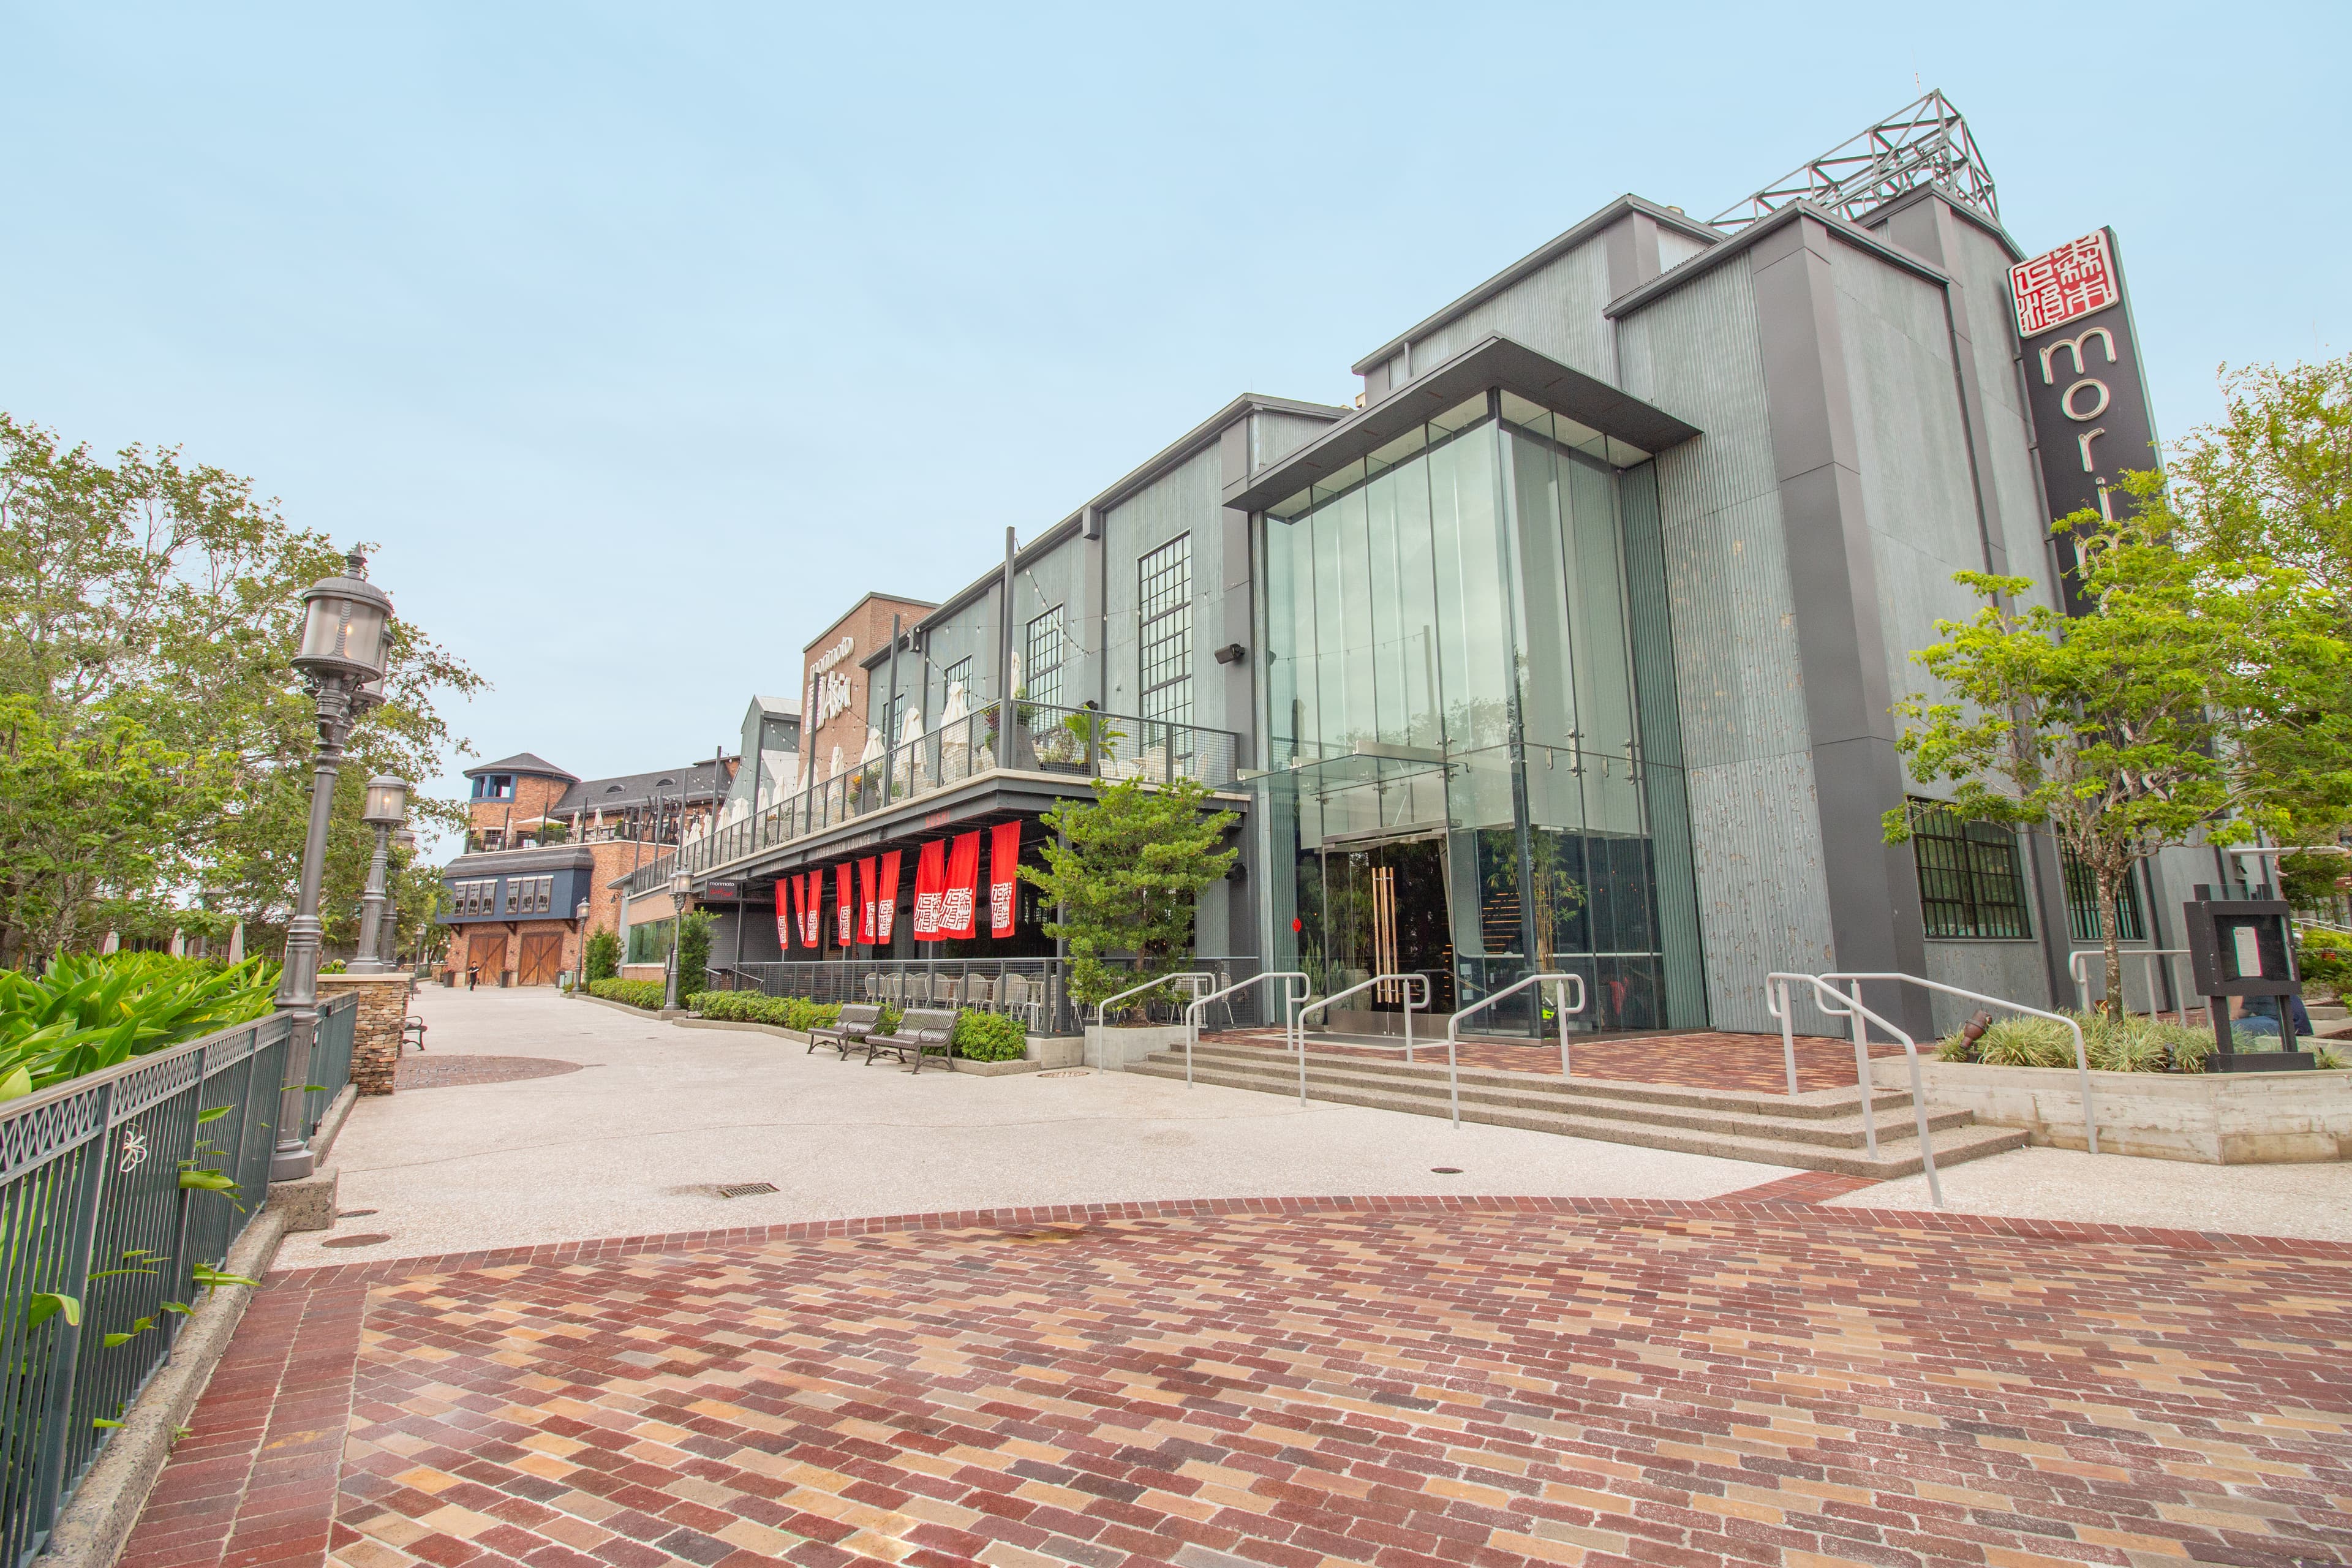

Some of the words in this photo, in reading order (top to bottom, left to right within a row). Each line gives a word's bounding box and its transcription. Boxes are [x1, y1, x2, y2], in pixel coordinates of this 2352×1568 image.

[925, 810, 951, 828] SUSHI
[816, 841, 845, 858] FORBIDDEN
[848, 834, 871, 850] LOUNGE
